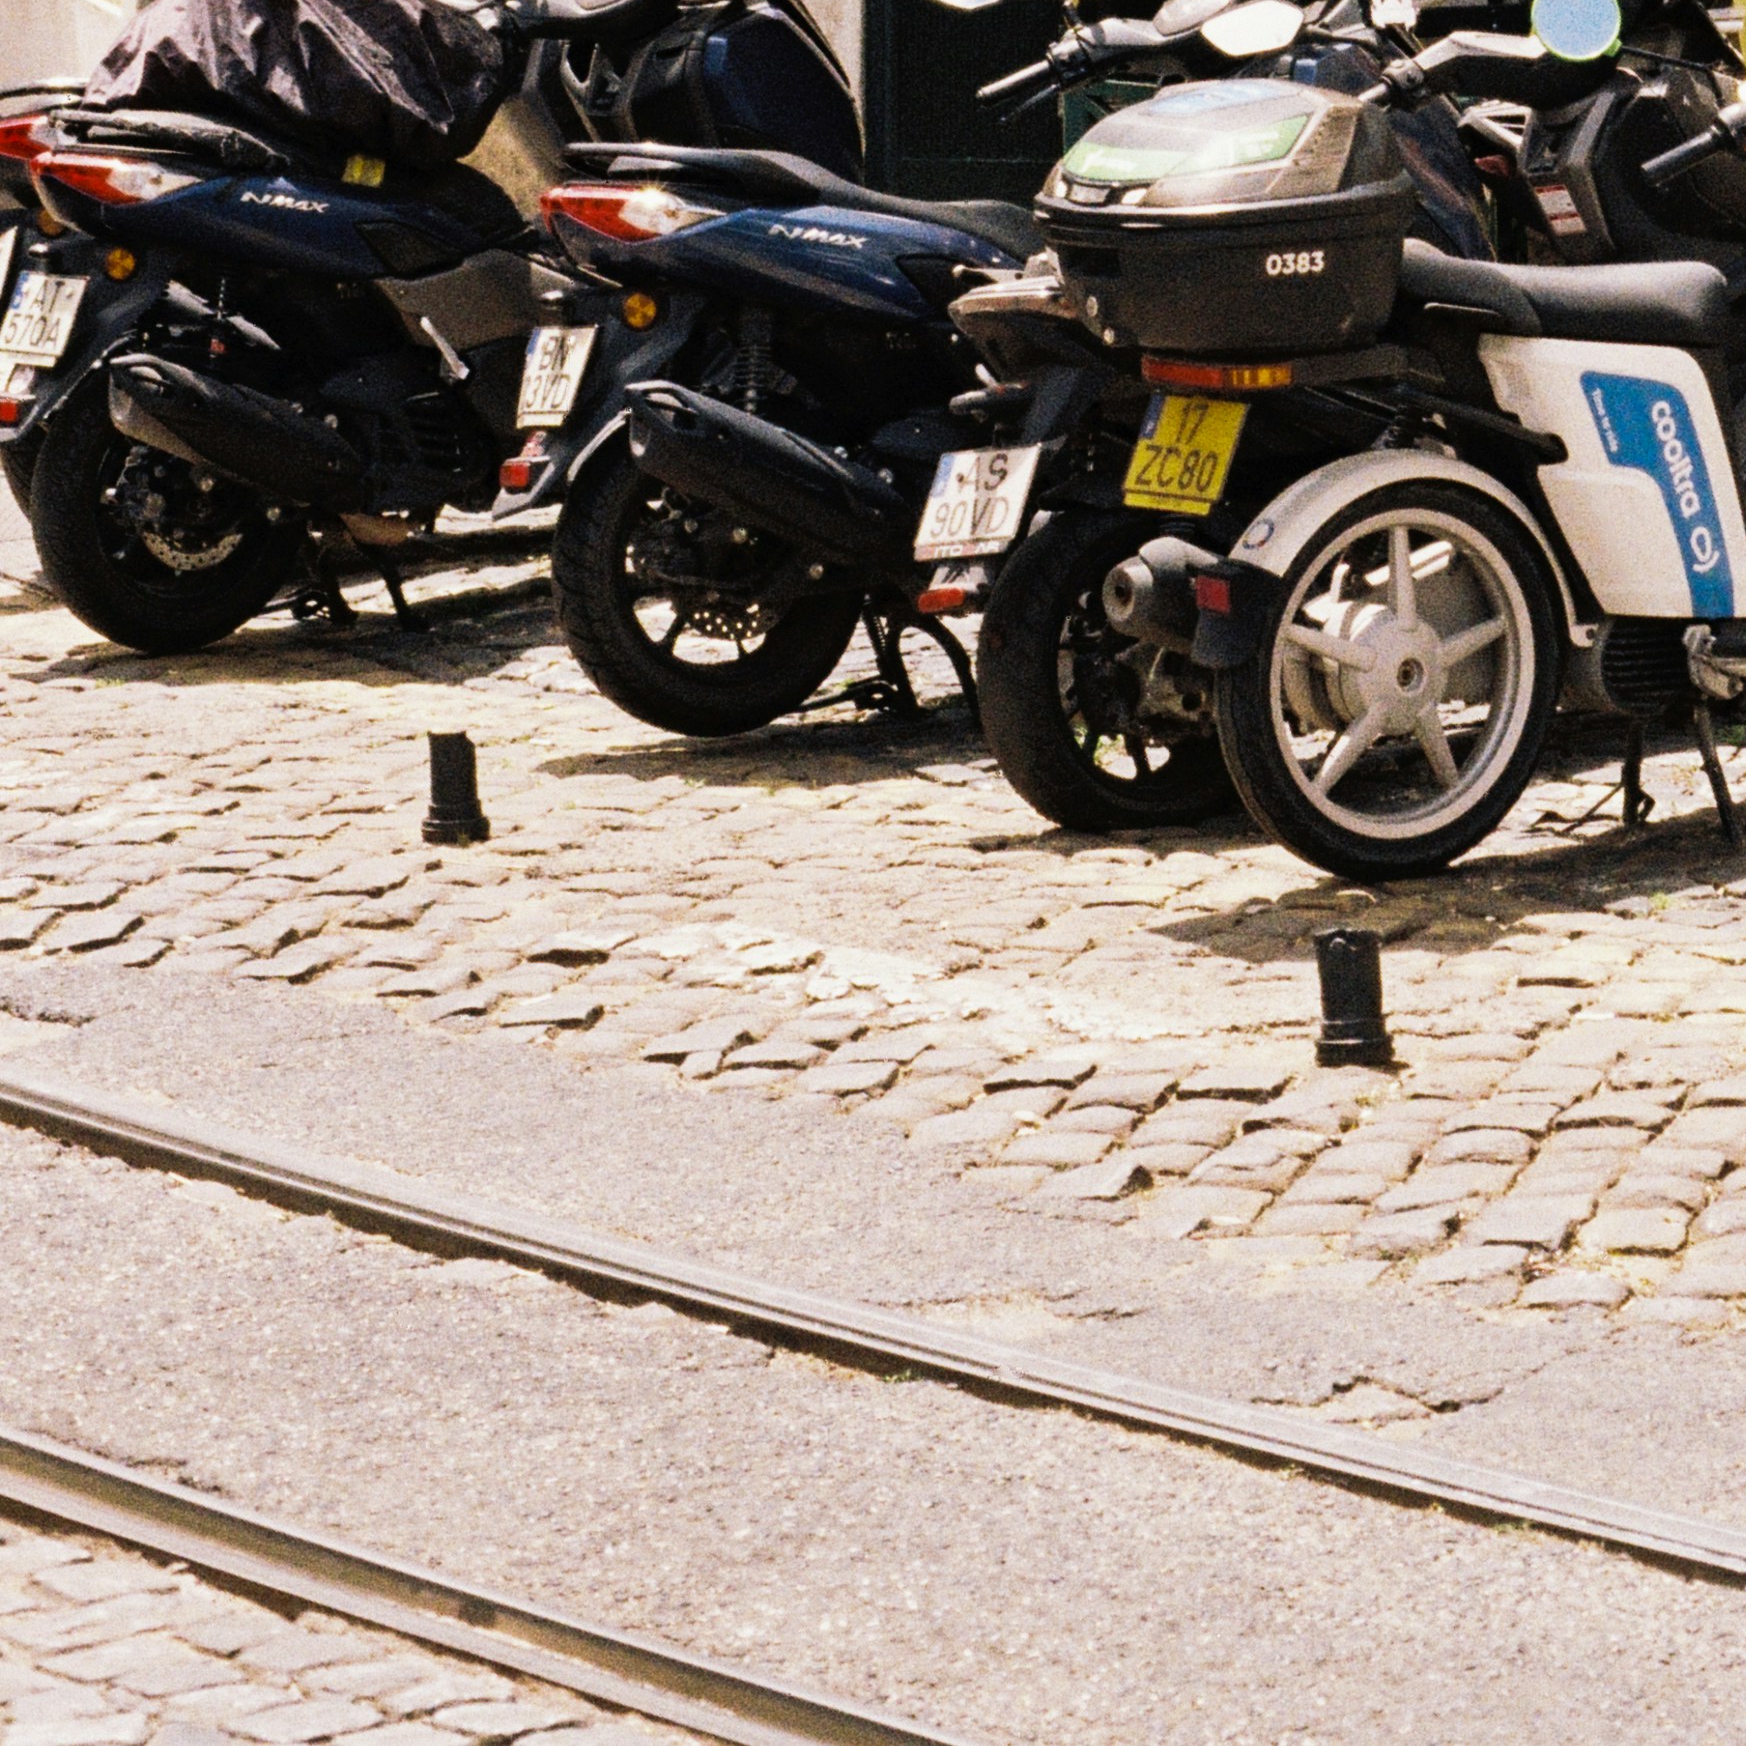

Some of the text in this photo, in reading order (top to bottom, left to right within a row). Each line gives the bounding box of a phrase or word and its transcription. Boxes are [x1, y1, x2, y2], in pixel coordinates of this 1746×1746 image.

[767, 223, 868, 249] NMAX
[1265, 251, 1325, 276] 0383
[29, 279, 67, 314] AT
[1175, 398, 1210, 446] 17
[957, 452, 1010, 492] AS
[1134, 443, 1219, 493] ZC80
[1651, 400, 1701, 519] cooltra
[928, 496, 1010, 538] 90VD
